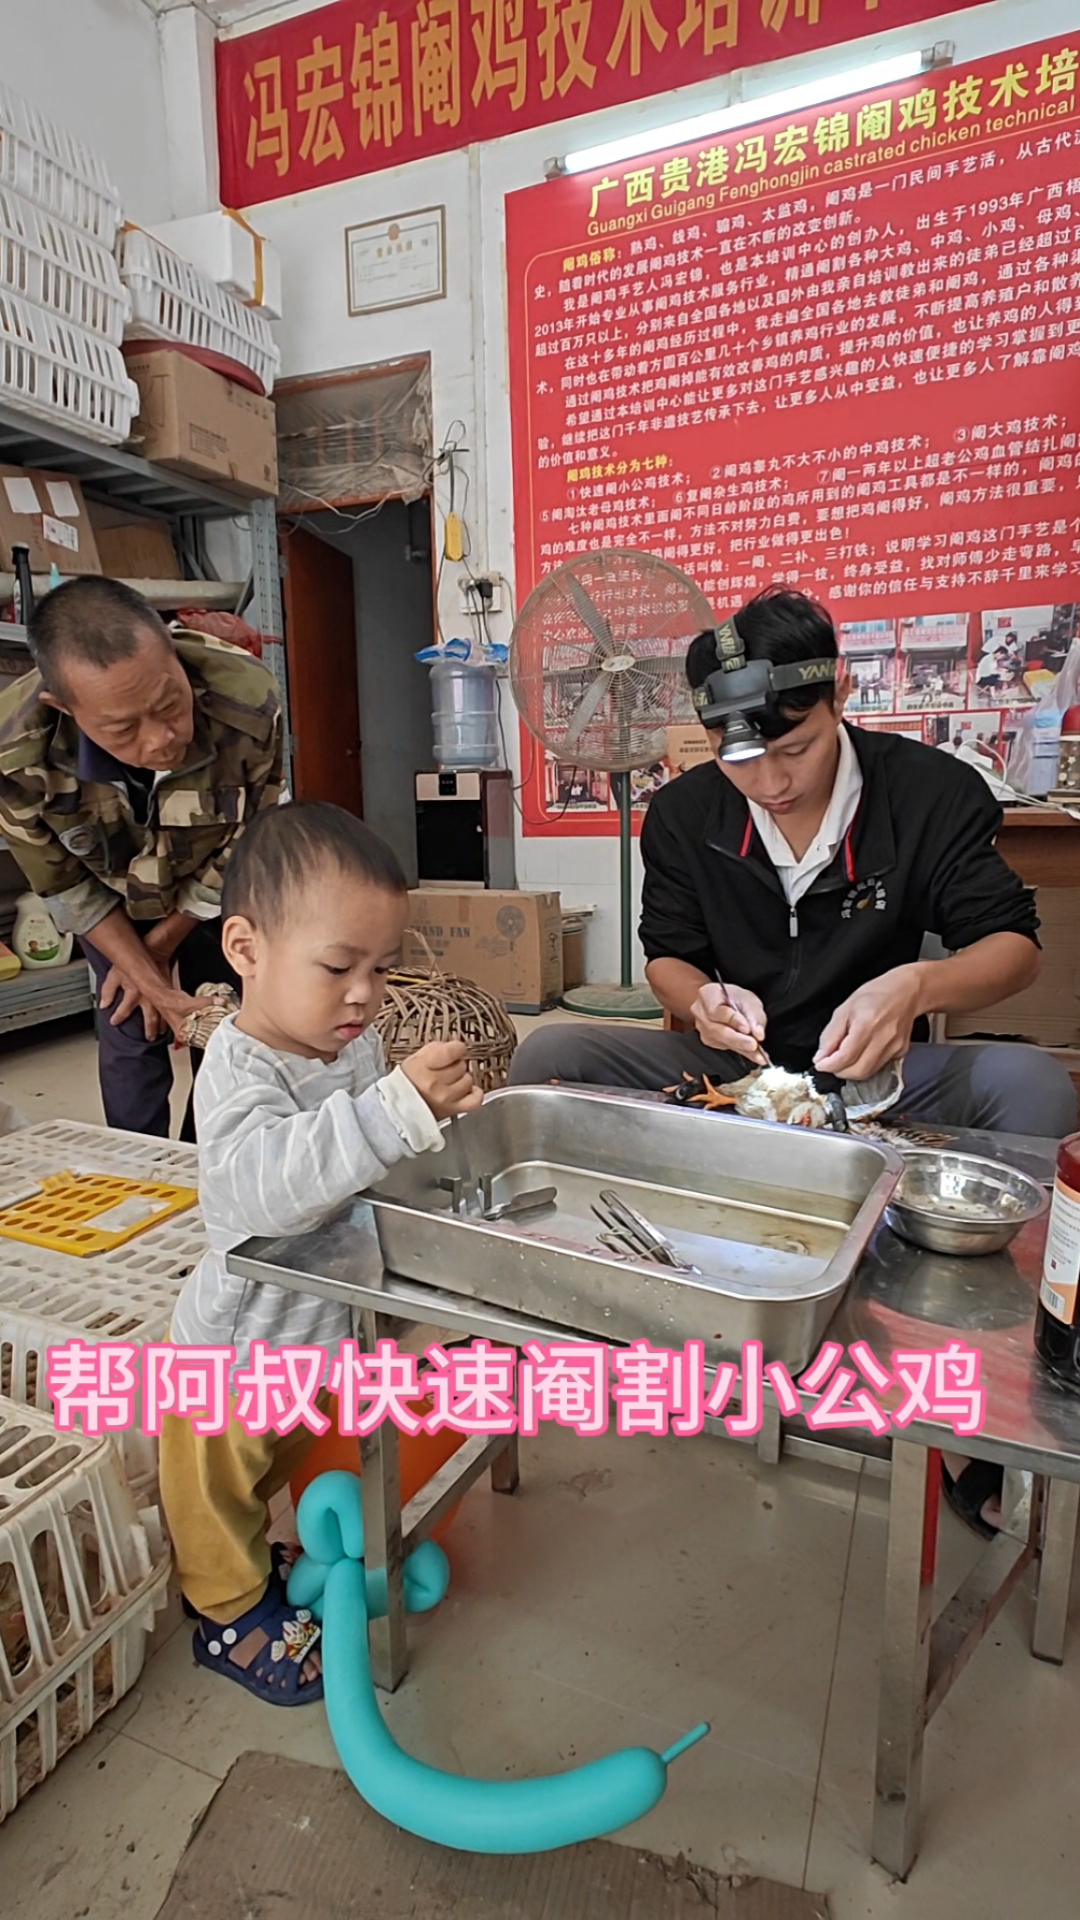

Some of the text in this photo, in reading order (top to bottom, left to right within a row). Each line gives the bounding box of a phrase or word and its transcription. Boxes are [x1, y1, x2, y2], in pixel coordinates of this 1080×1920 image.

[243, 0, 878, 177] 冯宏锦阉鸡技术
[586, 47, 1079, 218] 广西贵港冯宏锦阉鸡技术培
[586, 94, 1074, 236] Guangxi Guigang Fenghongjin castrated chicken technical
[537, 445, 617, 469] 的价值和意义。
[566, 453, 672, 482] 阉鸡技术分为七种：
[816, 432, 1080, 482] ⑦阉一两年以上超老公鸡血管结扎阉
[450, 926, 471, 938] FAN
